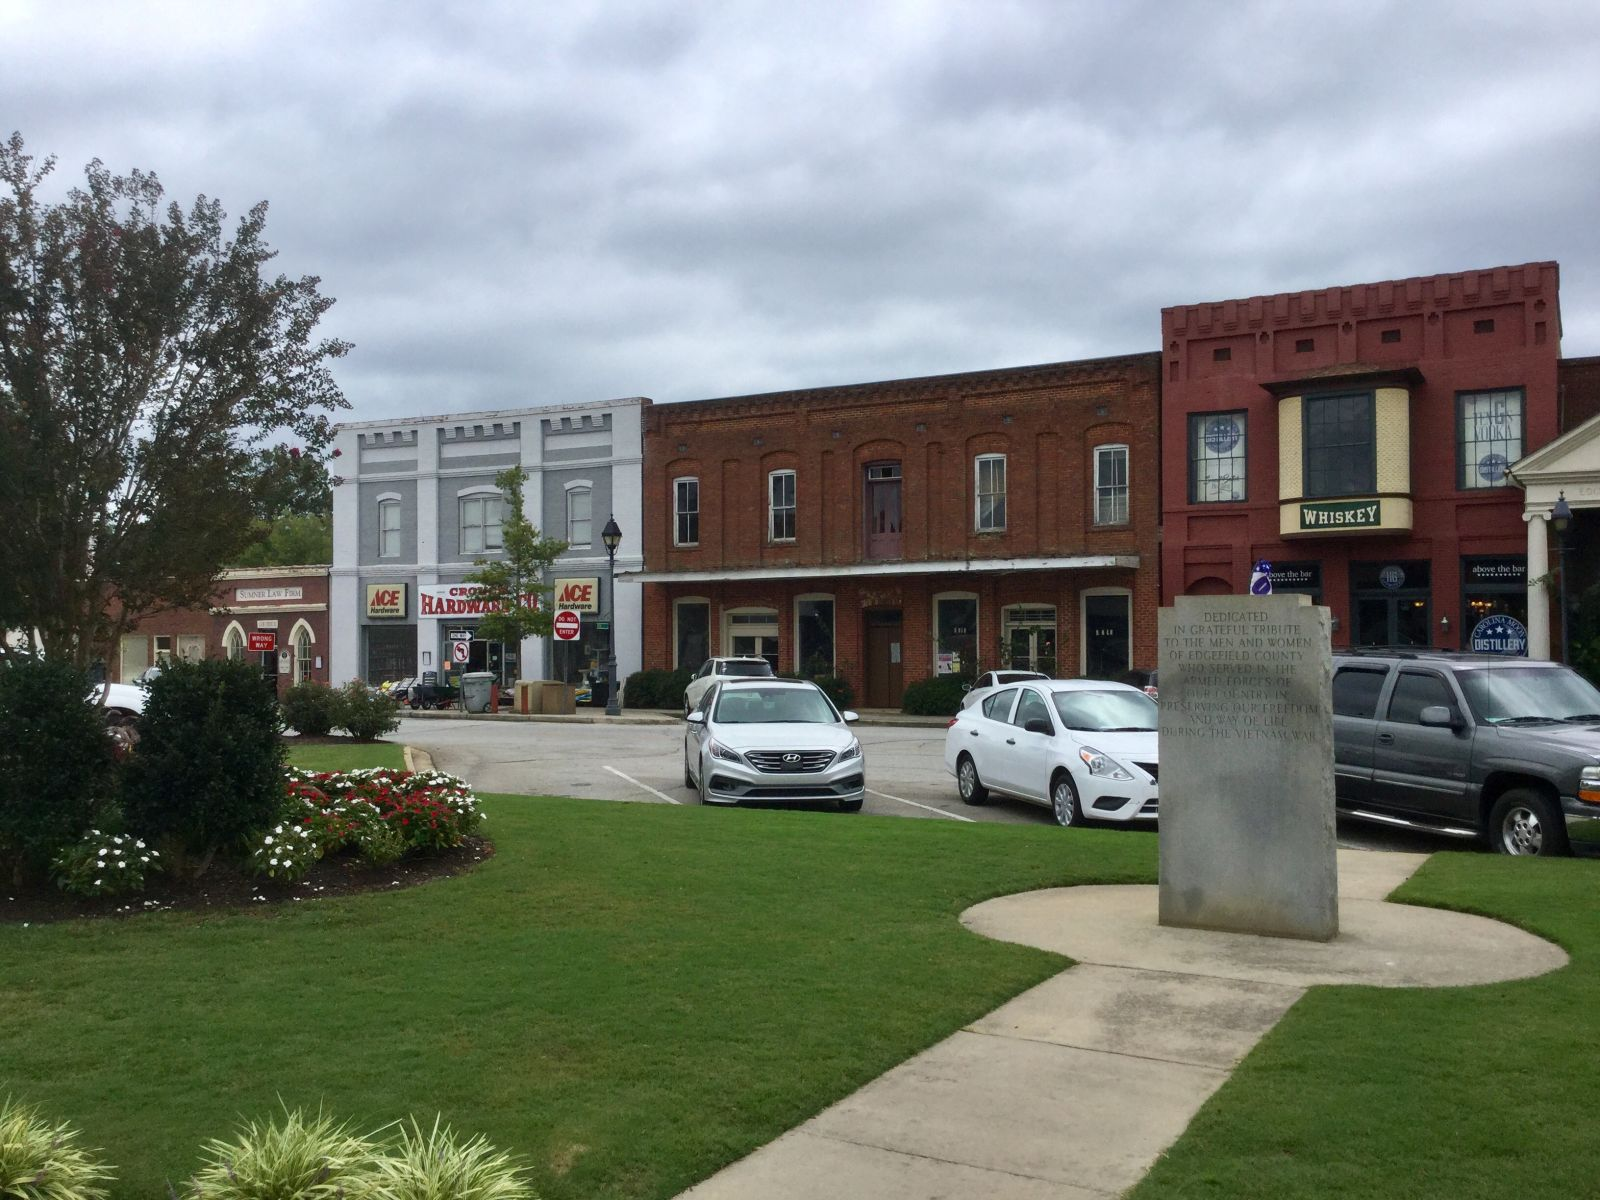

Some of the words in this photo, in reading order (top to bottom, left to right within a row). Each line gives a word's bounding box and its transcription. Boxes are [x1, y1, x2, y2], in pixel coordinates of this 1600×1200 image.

[1303, 505, 1378, 525] WHISKEY
[1287, 570, 1299, 578] the
[1472, 565, 1496, 573] above
[1497, 565, 1511, 573] the
[1512, 565, 1526, 573] bar
[267, 589, 282, 598] LAW
[370, 588, 401, 606] ACE
[558, 582, 593, 602] ACE
[370, 606, 400, 614] Hardware
[1204, 611, 1268, 623] DEDICATED
[1174, 624, 1185, 635] IN
[1190, 624, 1249, 635] GRATEFUL
[1251, 624, 1301, 635] TRIBUTE
[1474, 616, 1505, 638] CAROLINA
[1164, 637, 1179, 648] TO
[1183, 637, 1205, 648] THE
[1209, 637, 1234, 648] MEN
[1239, 637, 1263, 648] AND
[1267, 637, 1312, 648] WOMEN
[1474, 638, 1526, 651] DISTILLERY
[1169, 650, 1184, 661] OF
[1188, 650, 1250, 661] EDGEFIELD
[1254, 650, 1305, 661] COUNTY
[1178, 663, 1204, 674] WHO
[1210, 663, 1252, 674] SERVED
[1257, 663, 1269, 674] IN
[1275, 664, 1297, 675] THE
[1227, 676, 1272, 687] FORCES
[1277, 677, 1292, 688] OF
[1160, 702, 1229, 713] PRESERVING
[1233, 703, 1259, 713] OUR
[1263, 703, 1319, 714] FREEDOM
[1216, 716, 1240, 725] WAY
[1162, 727, 1206, 737] DURING
[1211, 728, 1232, 738] THE
